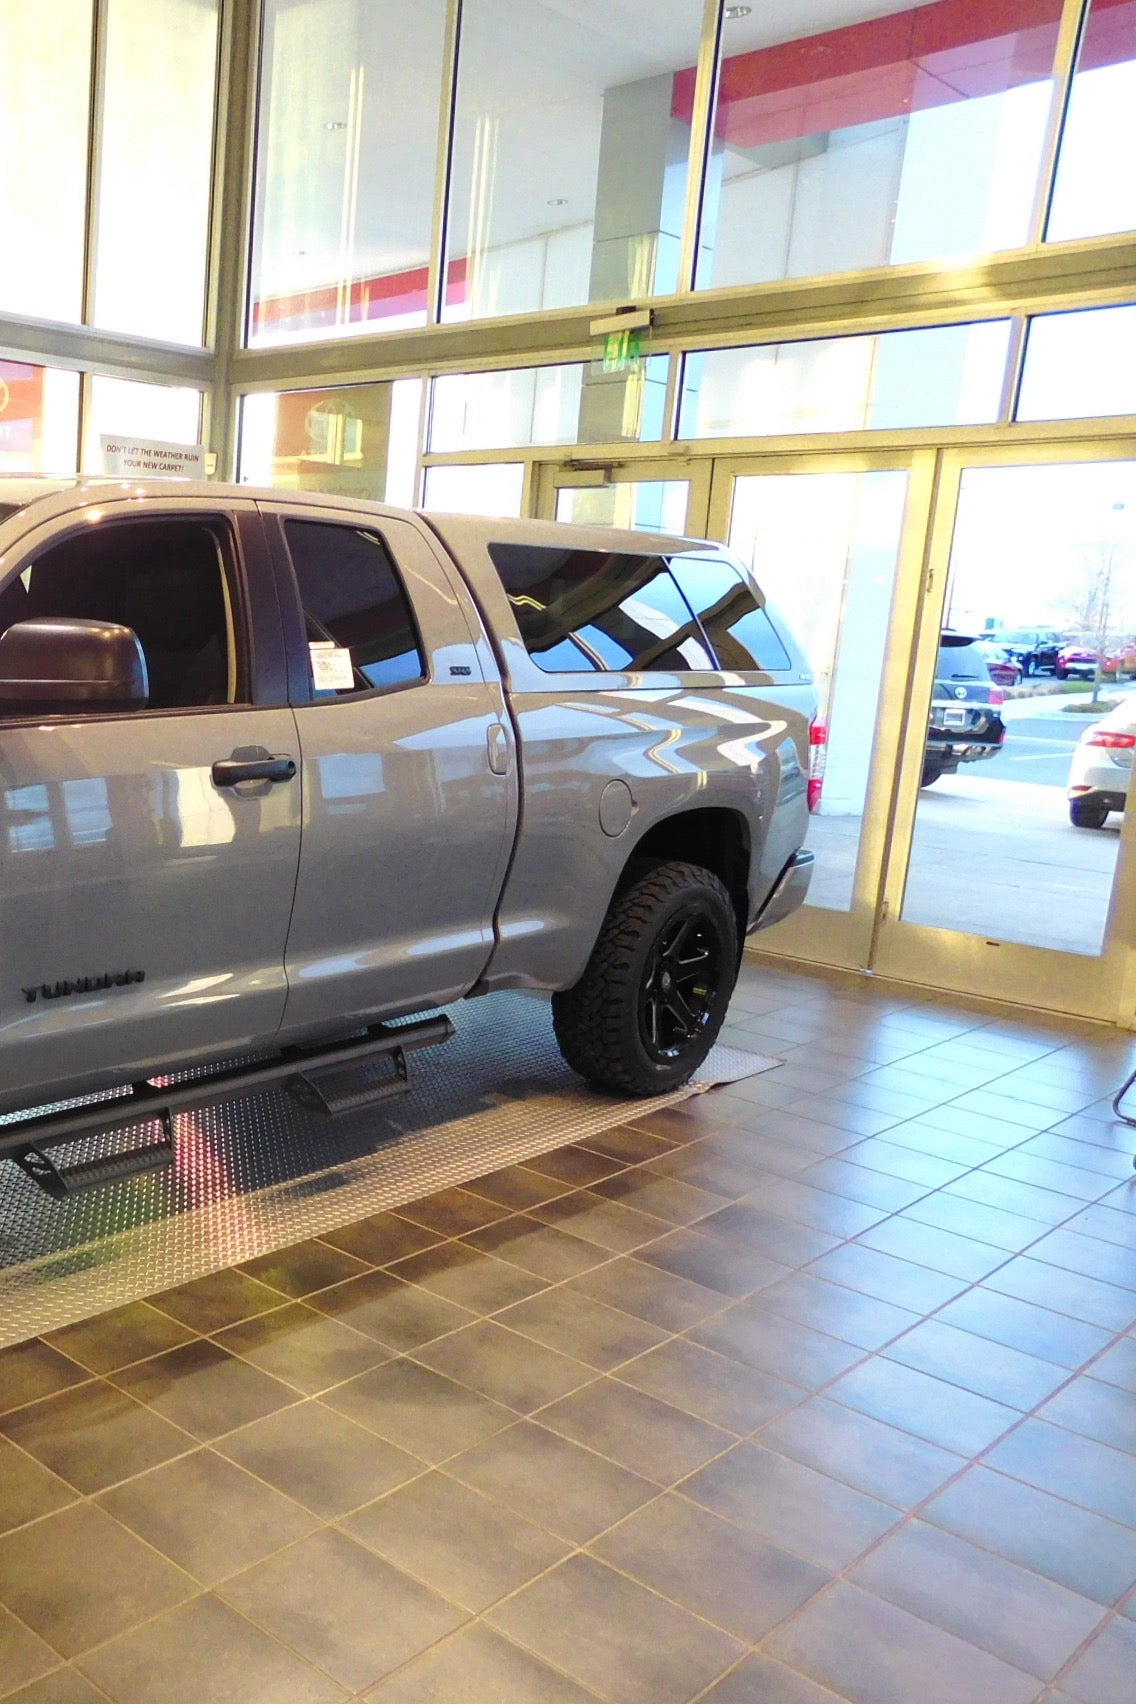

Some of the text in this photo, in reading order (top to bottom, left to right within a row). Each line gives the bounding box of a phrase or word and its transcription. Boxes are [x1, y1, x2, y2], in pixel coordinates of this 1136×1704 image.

[106, 444, 200, 462] DON'T LET THE WEATHER RUIN
[123, 458, 141, 467] YOUR
[143, 461, 159, 470] NEW
